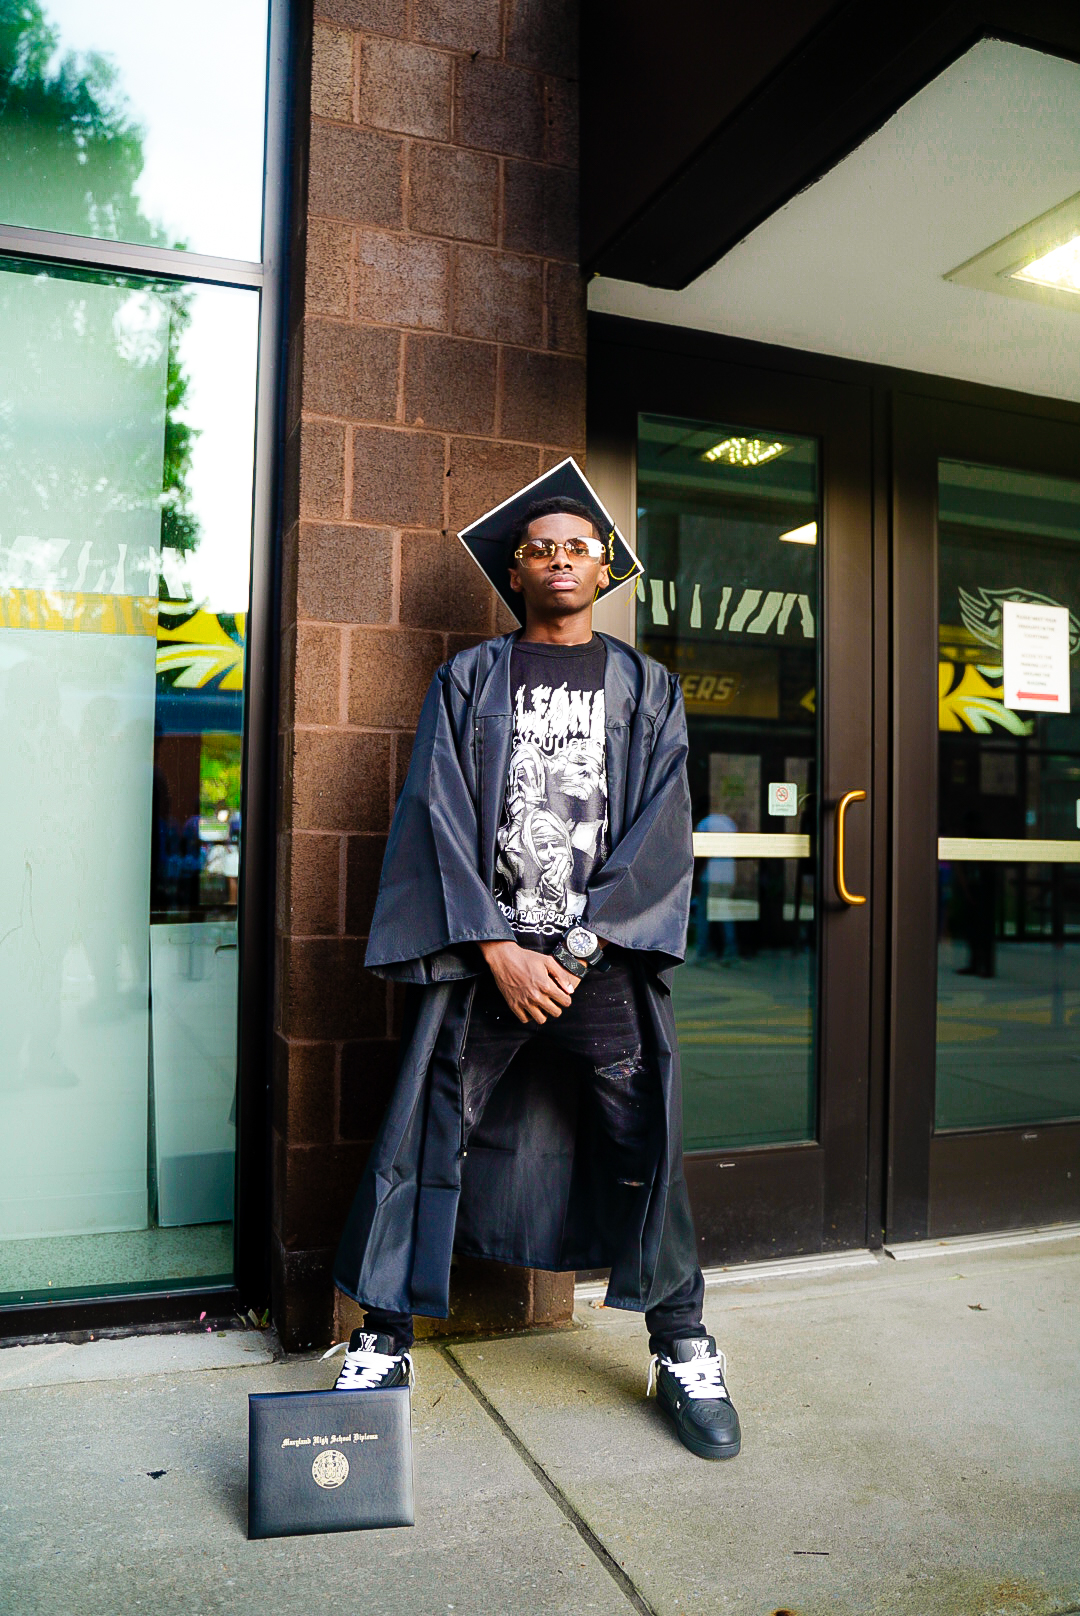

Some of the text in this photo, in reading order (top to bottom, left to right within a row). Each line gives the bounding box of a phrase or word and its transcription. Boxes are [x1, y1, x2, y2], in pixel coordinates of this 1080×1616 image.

[678, 674, 734, 700] ERS
[546, 909, 575, 928] STAY
[281, 1432, 379, 1449] Maryland High School Diploma
